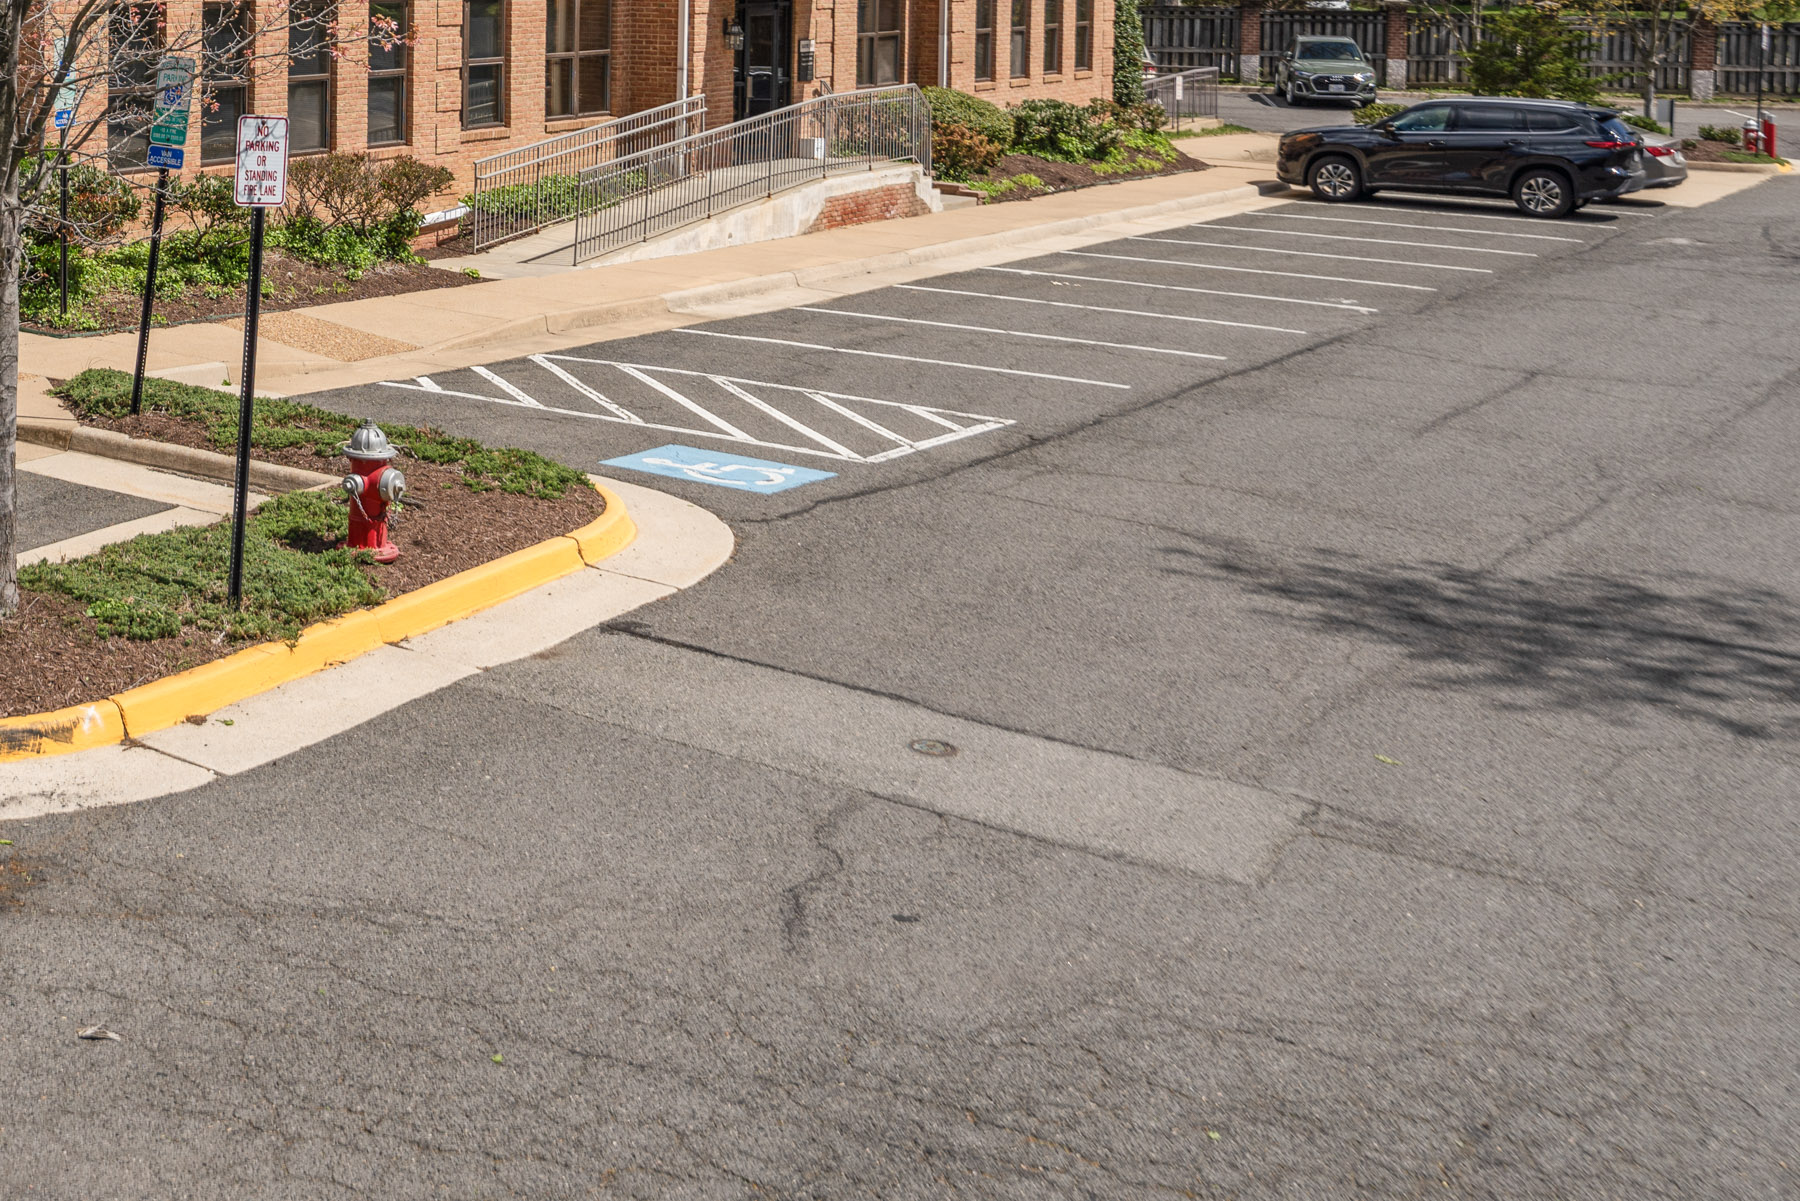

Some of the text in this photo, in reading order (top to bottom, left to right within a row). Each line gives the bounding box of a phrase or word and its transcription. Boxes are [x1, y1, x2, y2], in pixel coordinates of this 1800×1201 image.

[257, 126, 269, 137] NO
[245, 140, 280, 153] PARKING
[149, 155, 182, 166] ACCESSIBLE
[256, 155, 267, 167] OR
[244, 170, 278, 182] STANDING
[243, 184, 277, 196] FIRE LANE
